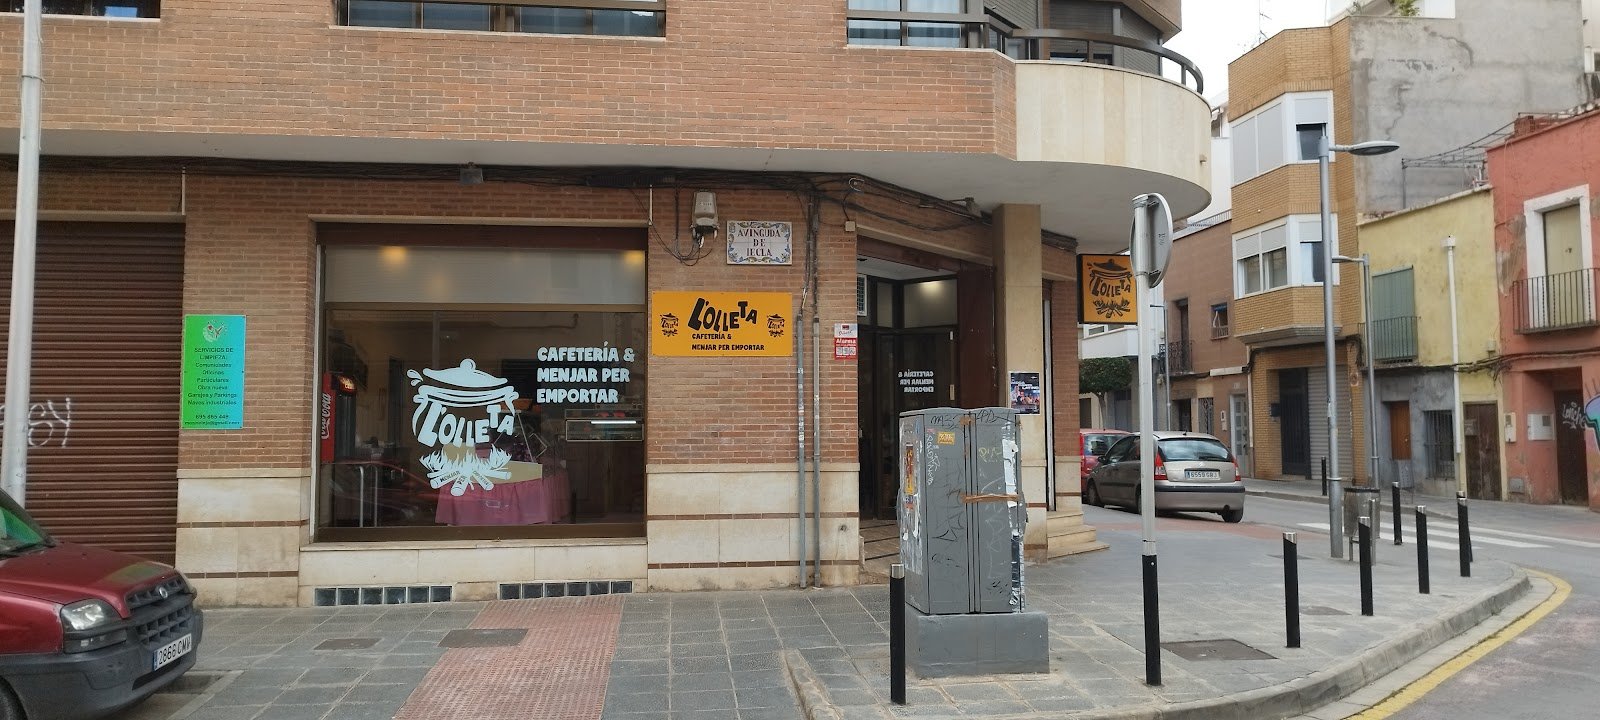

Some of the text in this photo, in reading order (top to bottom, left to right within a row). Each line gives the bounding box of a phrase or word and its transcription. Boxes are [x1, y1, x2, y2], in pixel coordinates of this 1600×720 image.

[738, 229, 781, 237] AVINGUDA
[753, 238, 766, 247] DE
[746, 248, 772, 257] IECLA
[1091, 276, 1131, 297] L'OLLETA
[687, 297, 758, 332] L'OLLETA
[691, 331, 726, 340] CAFETERÍA
[537, 341, 635, 362] CAFETERÍA &
[537, 367, 631, 383] MENJAR PER
[536, 388, 619, 403] EMPORTAR
[417, 400, 515, 448] L'OLLETA
